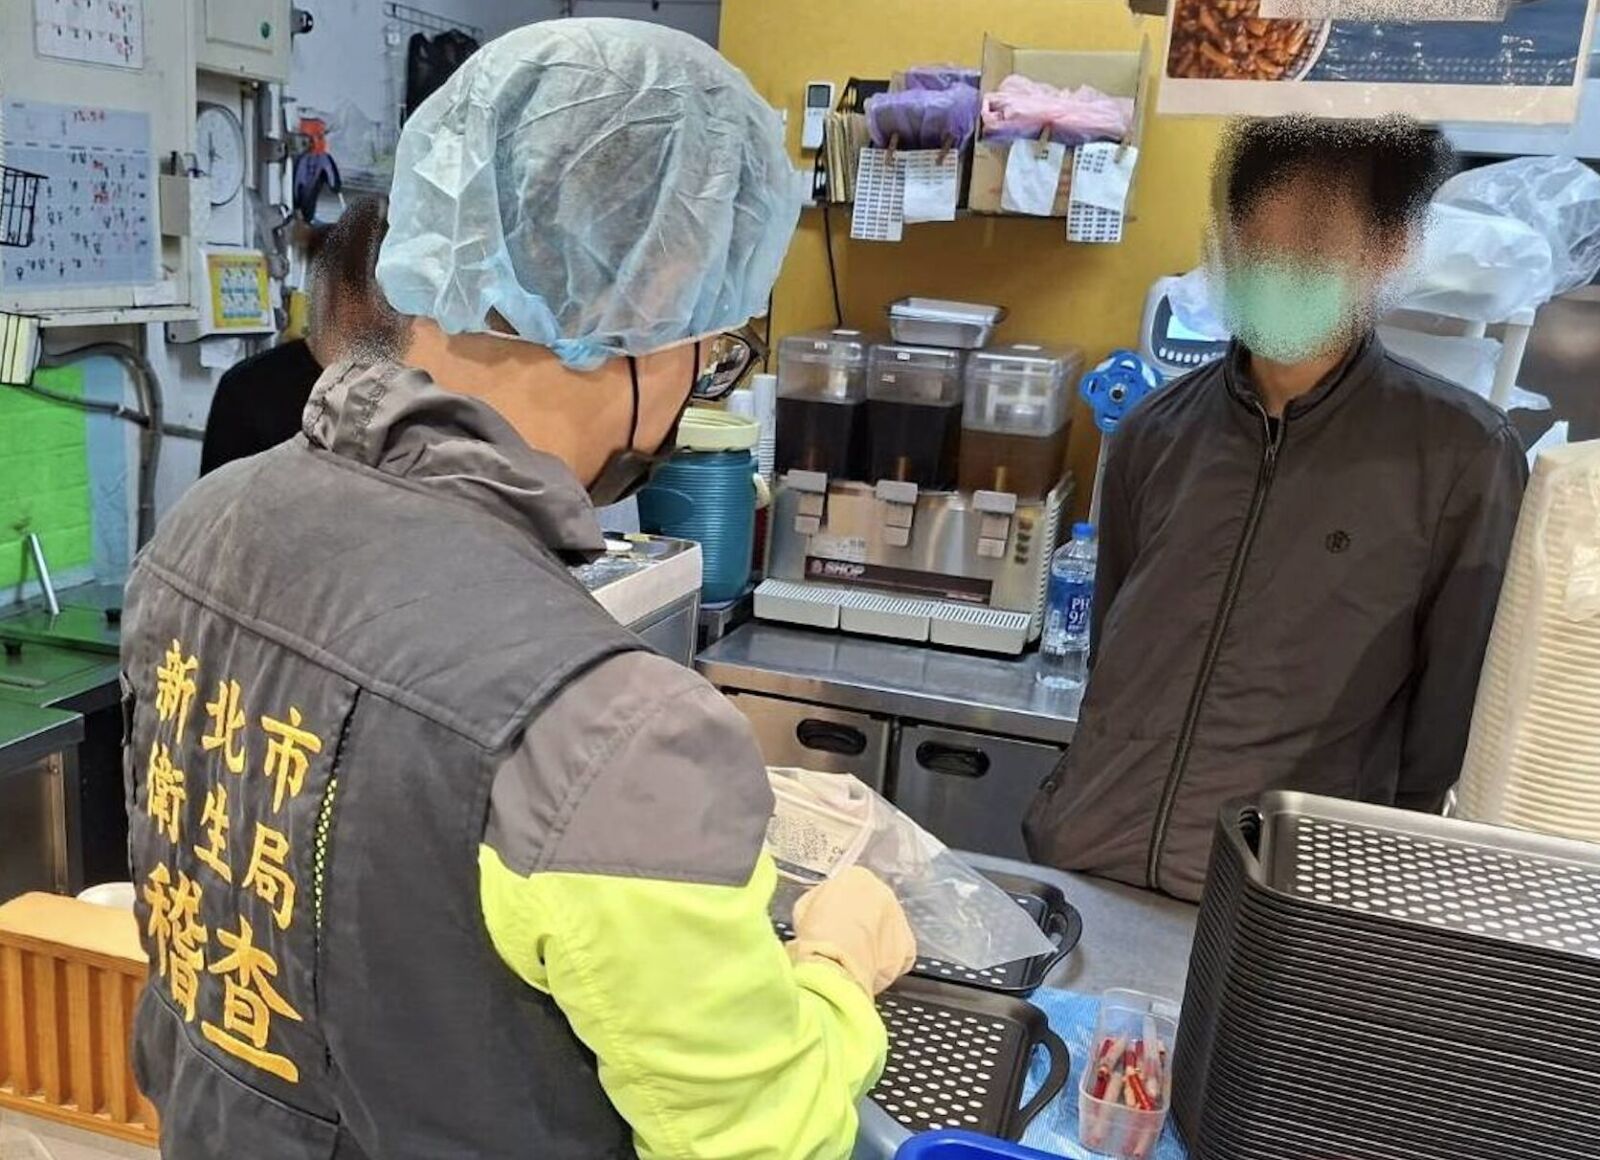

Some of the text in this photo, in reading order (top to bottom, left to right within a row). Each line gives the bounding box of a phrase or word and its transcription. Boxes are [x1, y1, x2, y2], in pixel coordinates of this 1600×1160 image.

[156, 639, 322, 813] 新北市
[146, 741, 296, 930] 衛生局
[143, 862, 304, 1083] 稽查
